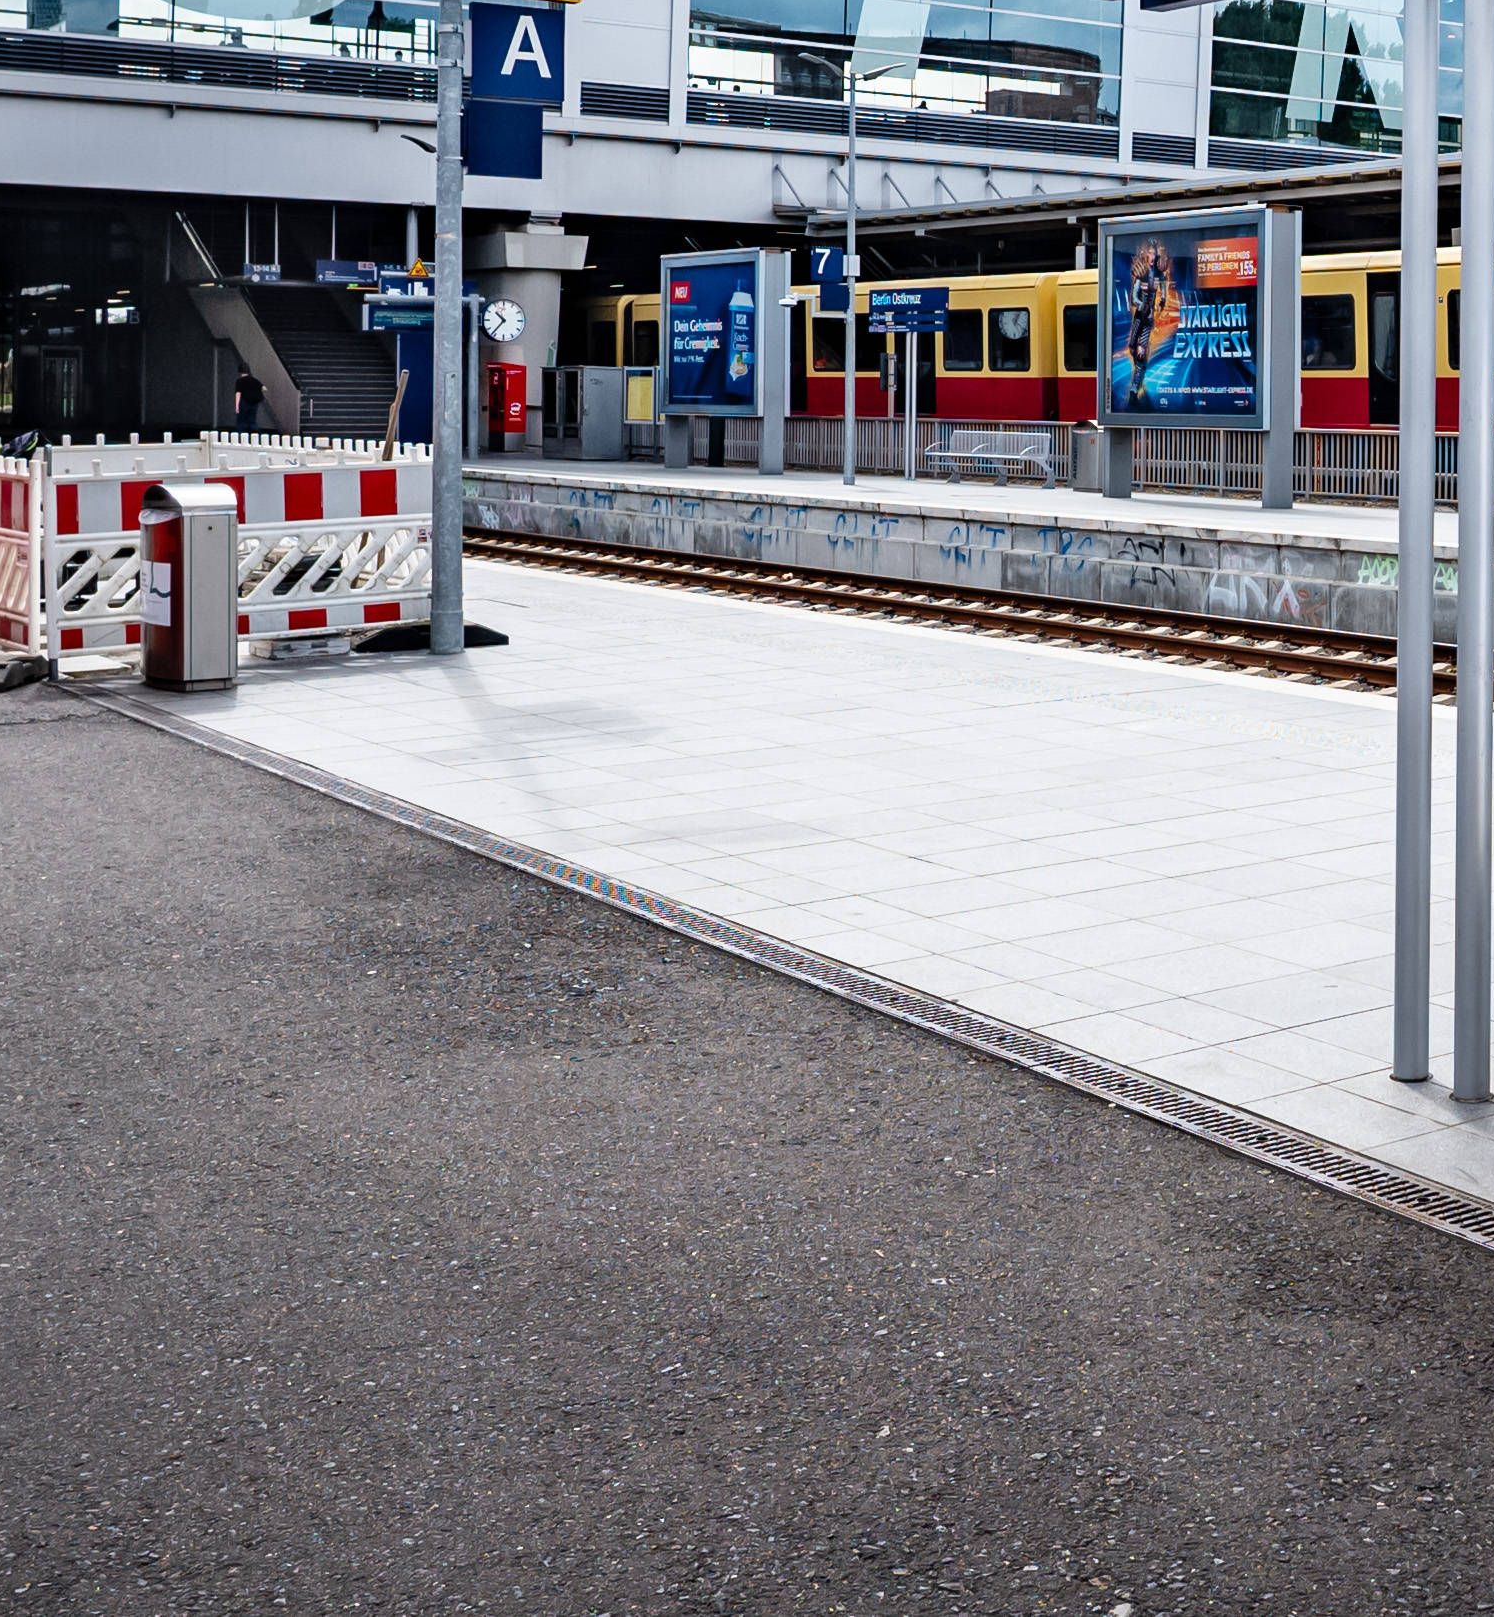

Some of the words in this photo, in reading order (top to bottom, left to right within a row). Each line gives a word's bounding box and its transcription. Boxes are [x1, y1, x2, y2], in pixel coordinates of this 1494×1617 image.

[501, 15, 553, 79] A
[816, 248, 830, 274] 7
[674, 286, 688, 298] NEU
[872, 293, 891, 305] Berlin
[892, 293, 921, 305] Ostkreuz
[674, 320, 688, 332] Dein
[690, 318, 723, 332] Geheimnis
[1178, 303, 1247, 329] STARLIGHT
[674, 337, 684, 350] für
[1173, 331, 1252, 358] EXPRESS
